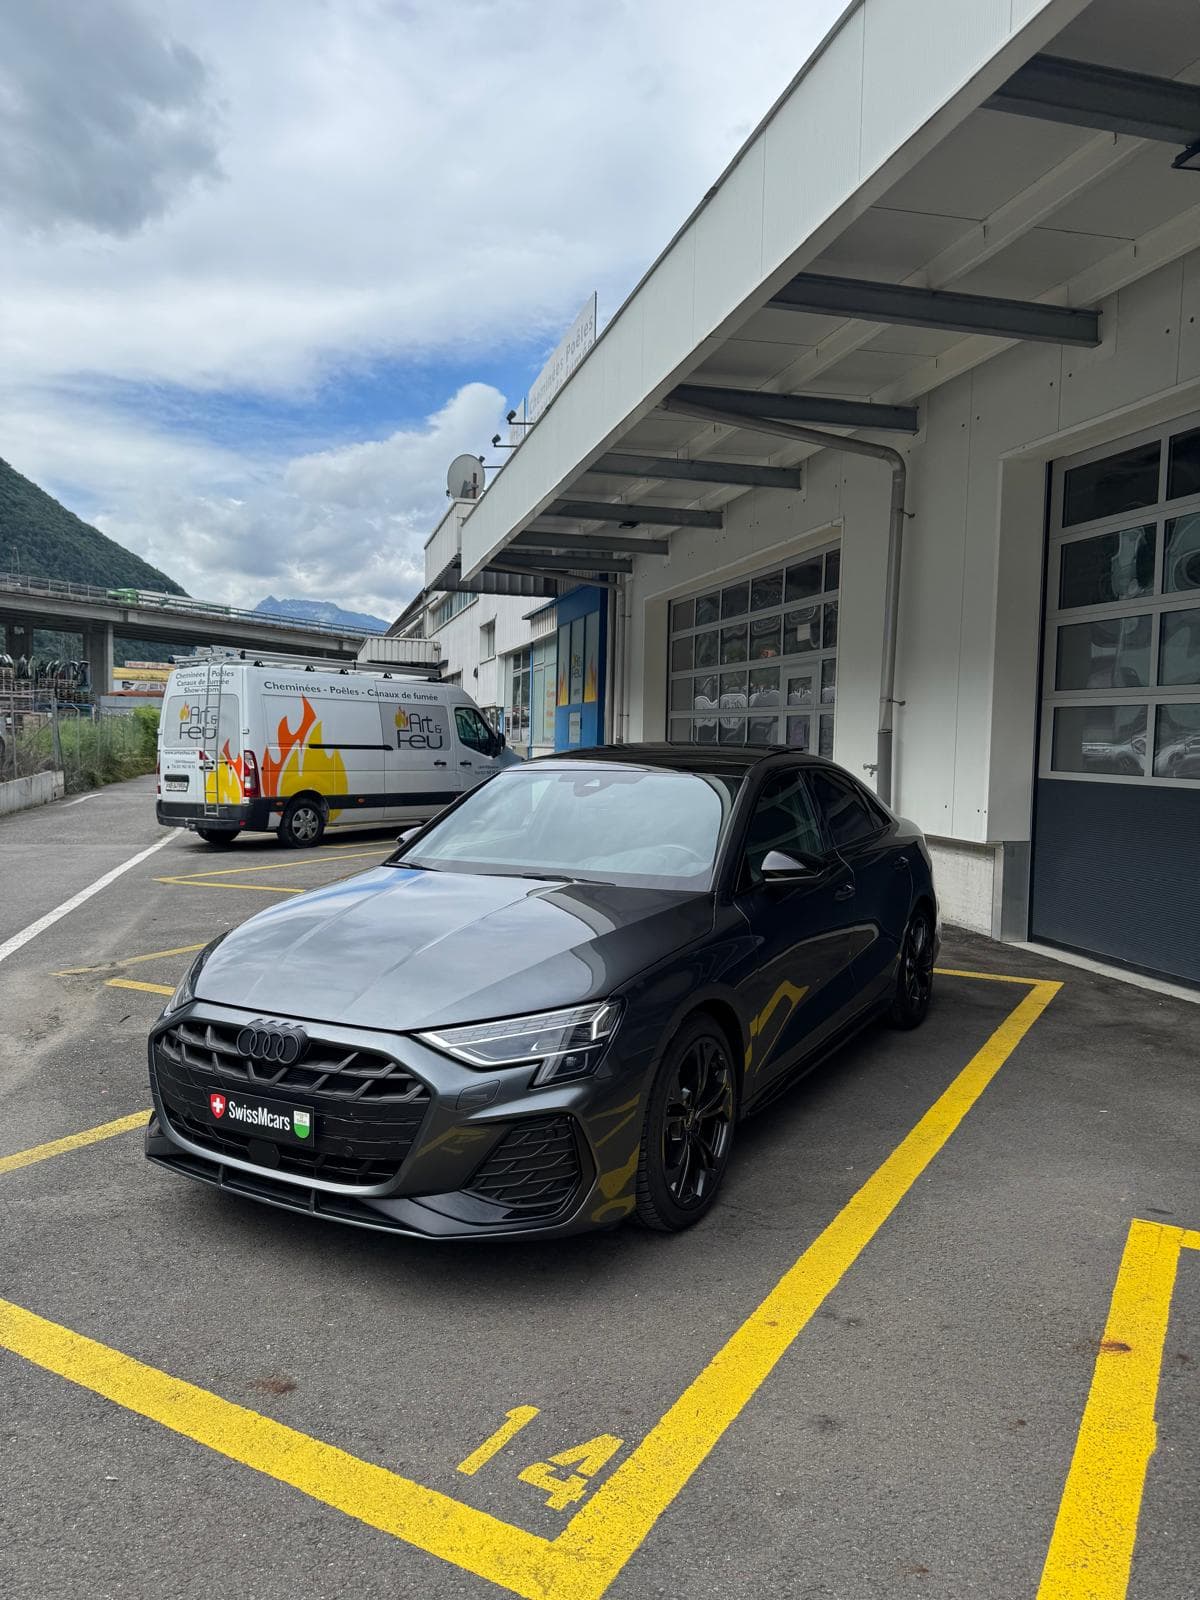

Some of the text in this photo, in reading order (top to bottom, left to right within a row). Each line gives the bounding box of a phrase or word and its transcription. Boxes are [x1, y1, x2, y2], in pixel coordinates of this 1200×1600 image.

[263, 681, 321, 694] Cheminées
[329, 685, 360, 696] Poêles
[367, 688, 400, 699] Canaux
[400, 691, 412, 700] de
[413, 693, 439, 701] fumée
[179, 721, 217, 740] Feu
[408, 713, 433, 734] Art
[397, 729, 444, 749] Feu
[228, 1101, 291, 1131] SwissMcars
[456, 1404, 625, 1512] 14
